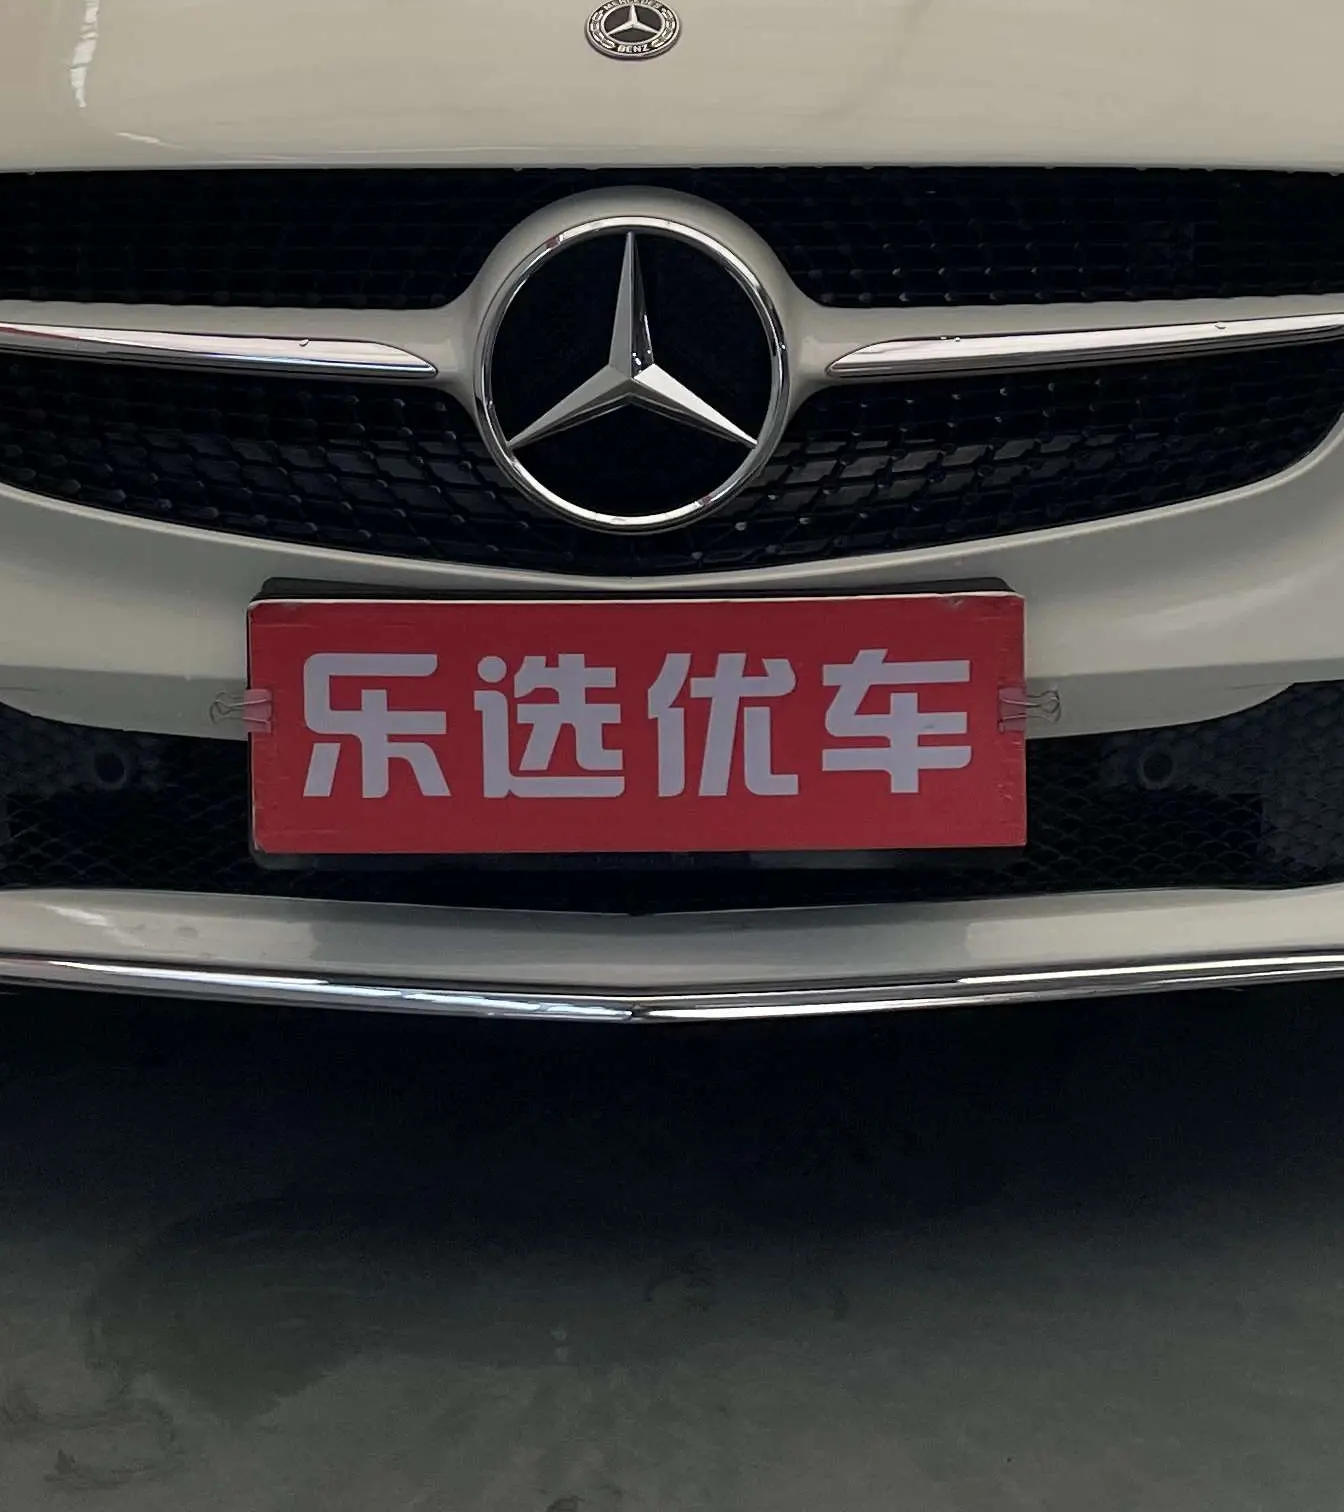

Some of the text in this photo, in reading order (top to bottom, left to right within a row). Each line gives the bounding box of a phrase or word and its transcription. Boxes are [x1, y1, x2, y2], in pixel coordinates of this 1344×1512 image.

[617, 44, 650, 53] BENZ
[302, 648, 973, 799] 乐选优车
